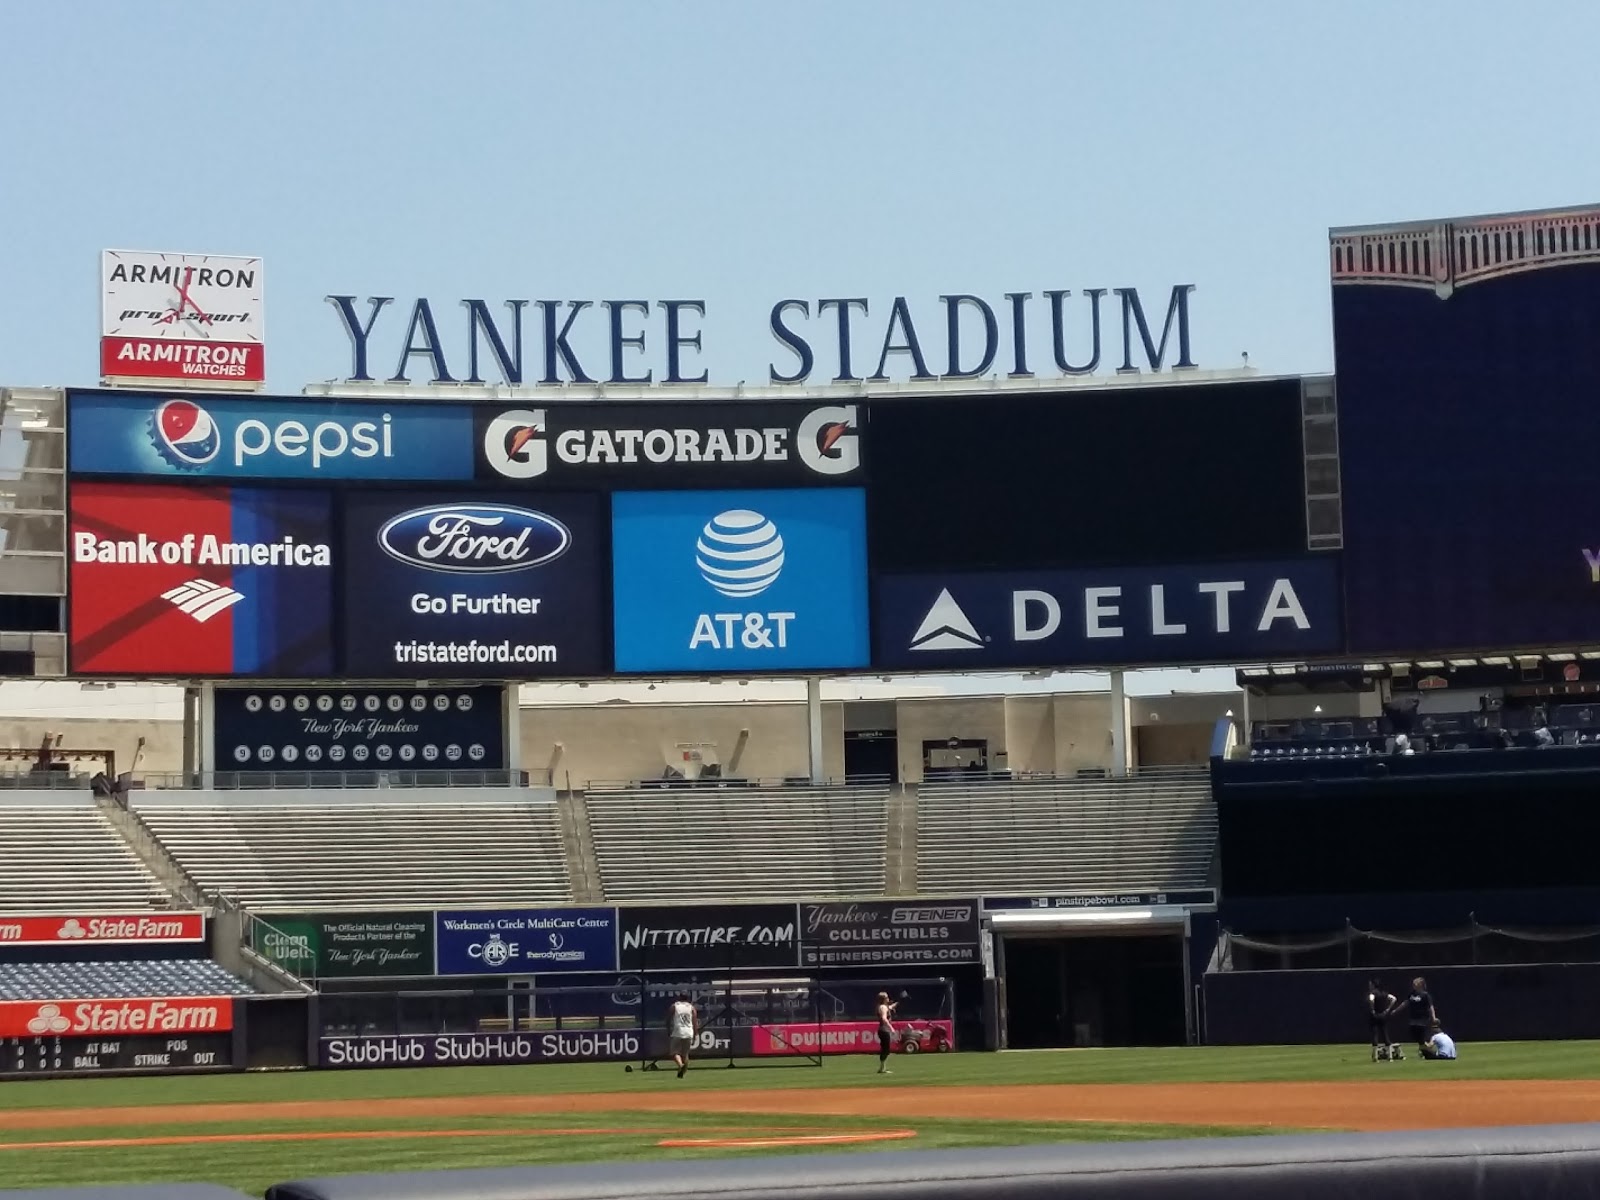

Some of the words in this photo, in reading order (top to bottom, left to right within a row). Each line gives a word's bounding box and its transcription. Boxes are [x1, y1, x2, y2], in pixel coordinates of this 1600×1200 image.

[109, 263, 255, 289] ARMITRON
[324, 295, 710, 386] YANKEE
[769, 284, 1199, 384] STADIUM
[117, 342, 248, 365] ARMITRON
[182, 362, 246, 376] WATCHES
[234, 413, 393, 468] pepsi
[555, 428, 788, 464] GATORADE
[417, 513, 533, 560] Ford
[74, 532, 158, 564] Bank
[161, 534, 195, 564] of
[198, 534, 331, 566] America
[411, 593, 447, 614] Go
[452, 593, 541, 614] Further
[1012, 578, 1311, 641] DELTA
[688, 611, 796, 650] AT&T
[394, 639, 557, 663] tristateford.com
[301, 718, 333, 733] New
[333, 718, 364, 739] York
[366, 717, 419, 740] Yankees
[1055, 895, 1141, 908] pinstripebowl.com
[323, 924, 337, 932] The
[338, 924, 365, 932] Official
[366, 923, 392, 931] Natural
[394, 922, 426, 932] Cleaning
[444, 919, 495, 930] Workmen's
[497, 919, 525, 929] Circle
[527, 918, 575, 929] MultiCare
[577, 917, 609, 928] Center
[806, 903, 879, 934] Yankees
[894, 908, 969, 921] STEINER
[333, 933, 366, 941] Products
[367, 932, 394, 941] Partner
[395, 932, 403, 940] of
[404, 932, 416, 940] the
[828, 927, 949, 941] COLLECTIBLES
[327, 949, 350, 961] New
[352, 949, 377, 966] York
[379, 948, 421, 966] Yankees
[807, 949, 973, 962] STEINERSPORTS.COM
[86, 1043, 99, 1054] AT
[102, 1042, 120, 1054] BAT
[167, 1040, 188, 1051] POS
[328, 1039, 425, 1064] StubHub
[434, 1035, 531, 1061] StubHub
[541, 1033, 639, 1056] StubHub
[74, 1056, 100, 1068] BALL
[134, 1054, 171, 1066] STRIKE
[194, 1052, 216, 1064] OUT
